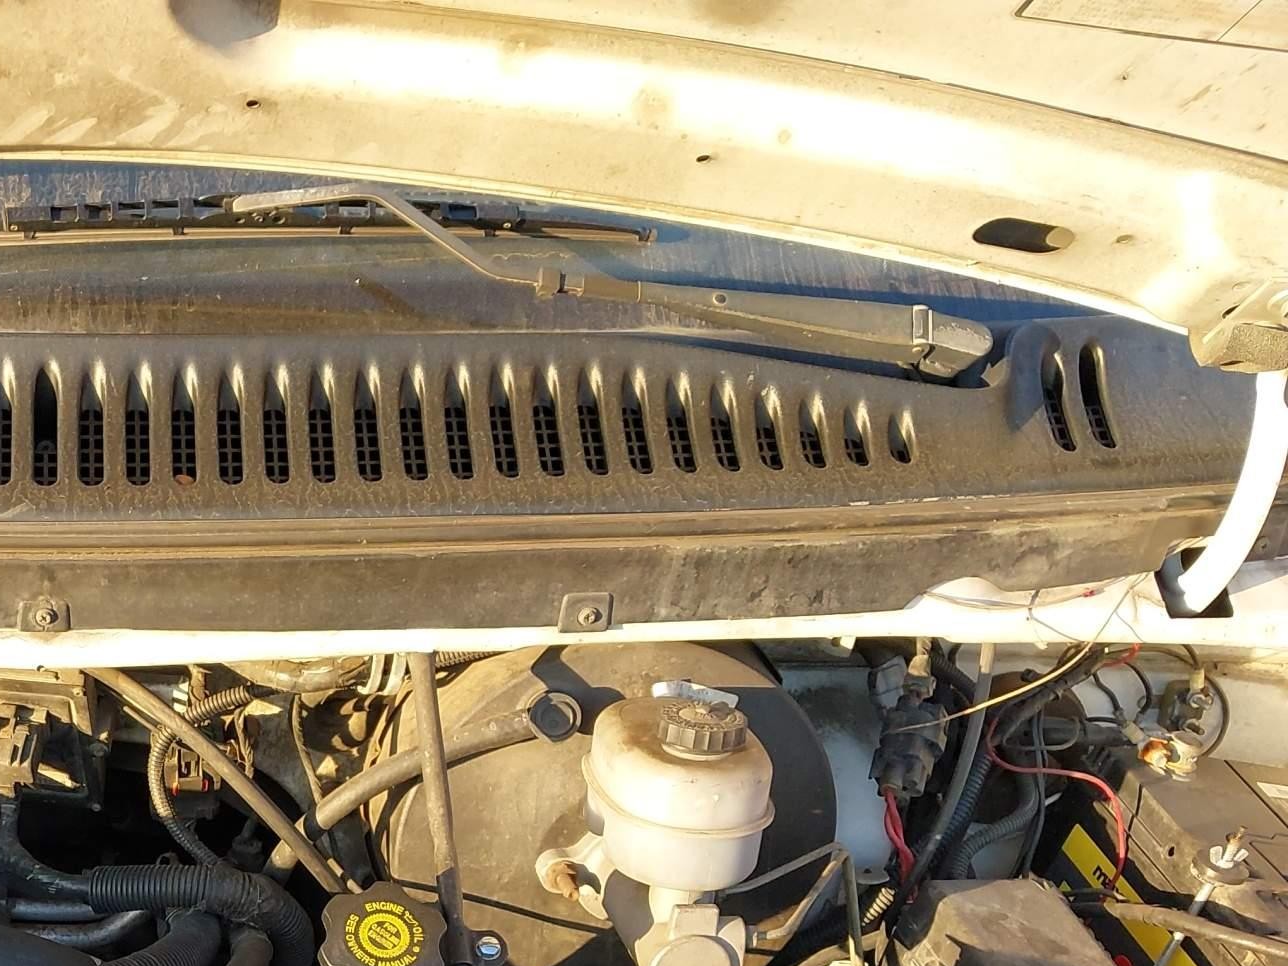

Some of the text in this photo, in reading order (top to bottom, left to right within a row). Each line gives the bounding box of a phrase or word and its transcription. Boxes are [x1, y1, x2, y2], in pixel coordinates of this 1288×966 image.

[346, 914, 359, 933] SEE
[365, 902, 424, 943] ENGINE OIL
[346, 934, 376, 966] OWNERS
